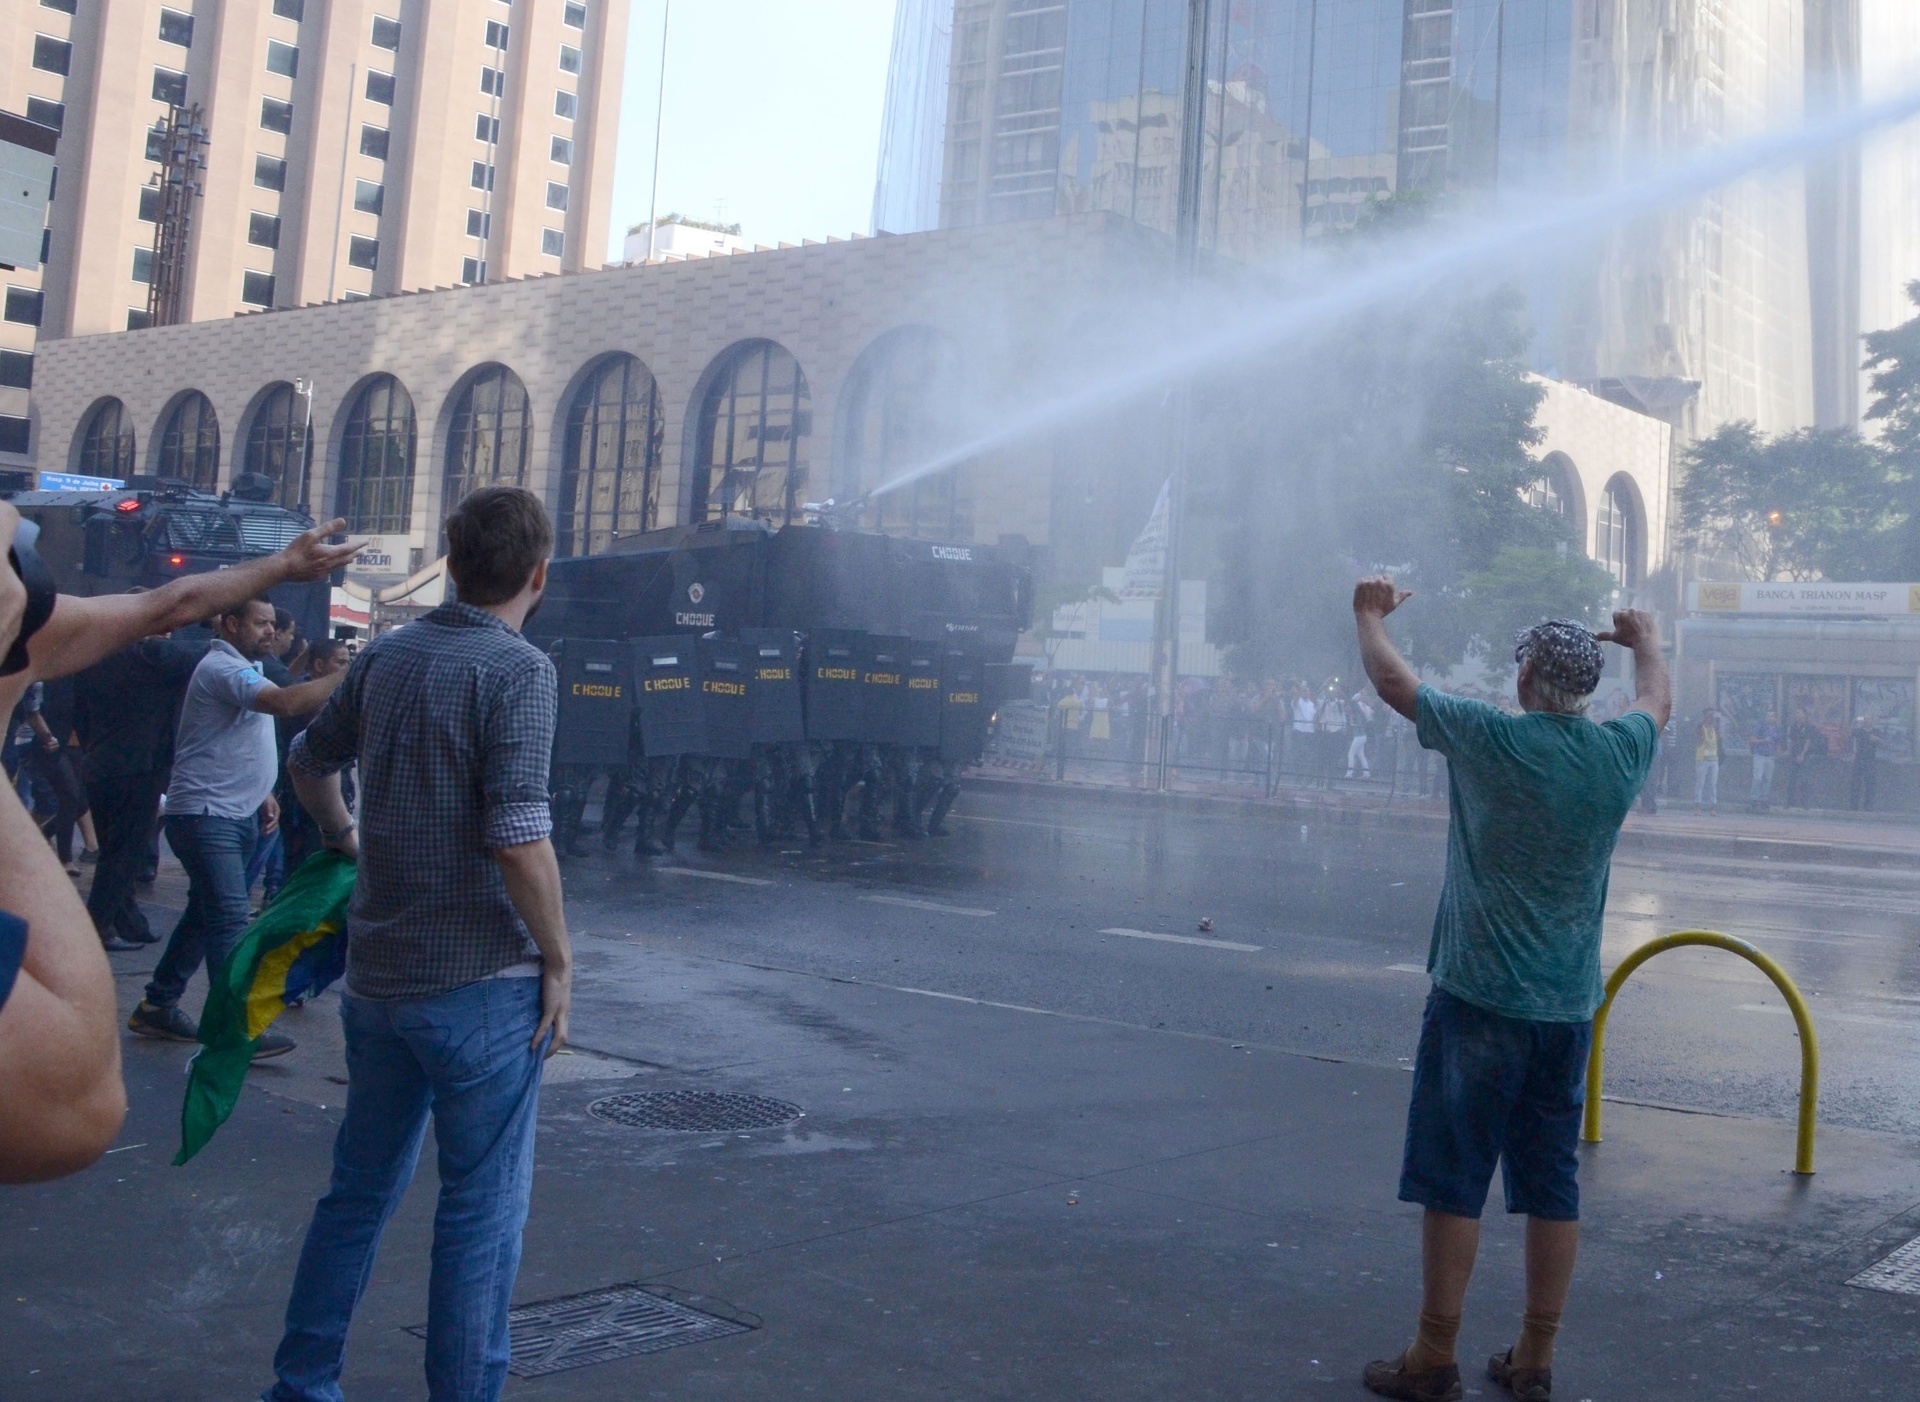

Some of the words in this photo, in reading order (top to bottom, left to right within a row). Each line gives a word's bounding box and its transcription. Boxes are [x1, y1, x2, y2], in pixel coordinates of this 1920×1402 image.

[1756, 590, 1795, 600] BANCA
[1801, 590, 1851, 601] TRIANON
[1855, 590, 1888, 601] MASP
[908, 678, 938, 689] HOQUE
